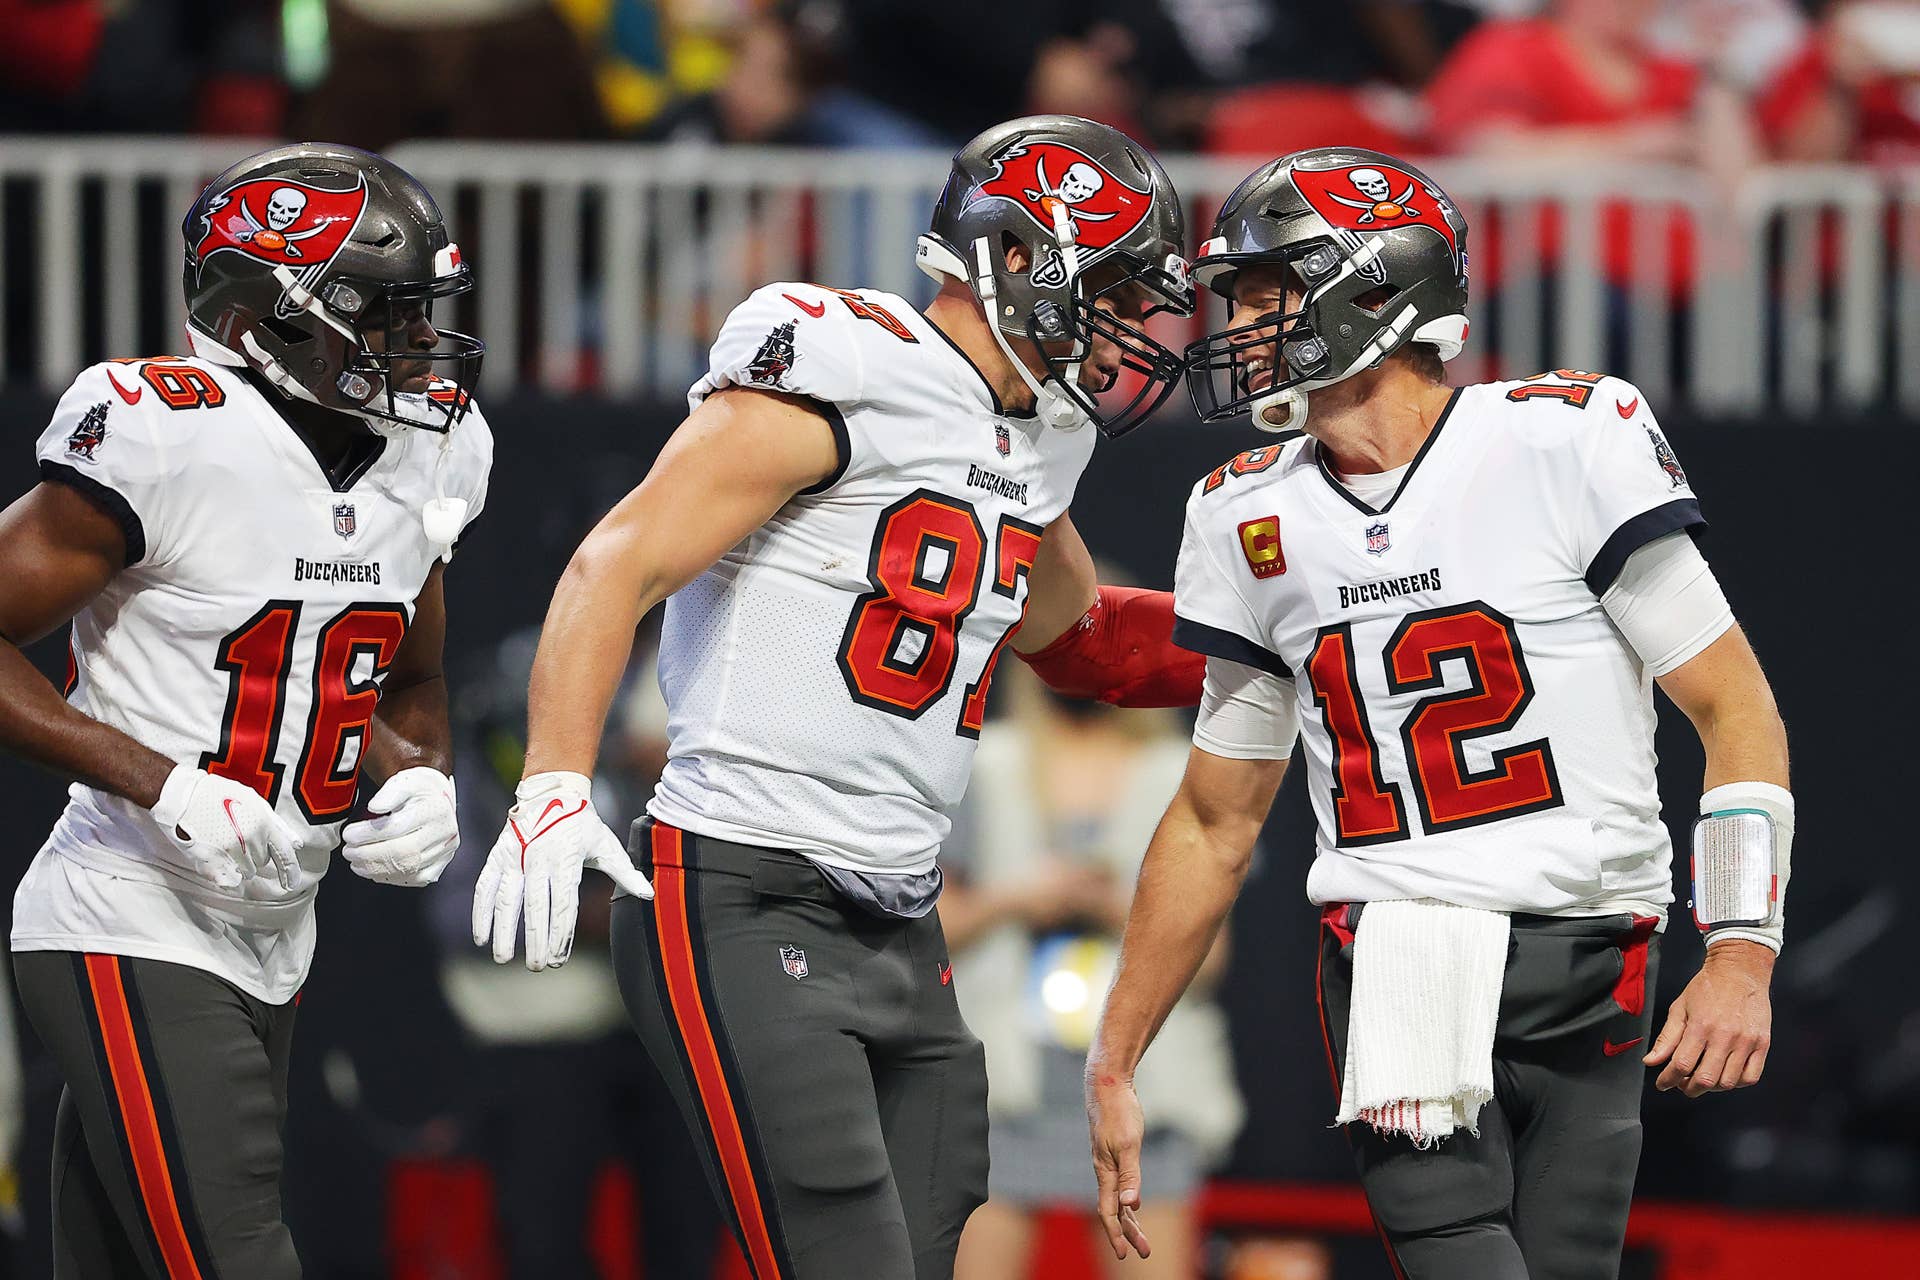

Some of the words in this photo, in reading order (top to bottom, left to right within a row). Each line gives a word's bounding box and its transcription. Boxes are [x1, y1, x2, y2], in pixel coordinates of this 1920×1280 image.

[966, 463, 1028, 506] BUCCANEERS
[1243, 521, 1278, 564] C
[294, 557, 381, 587] BUCCANEERS
[1337, 567, 1442, 609] BUCCANEERS
[198, 599, 410, 826] 16
[1303, 599, 1566, 849] 12
